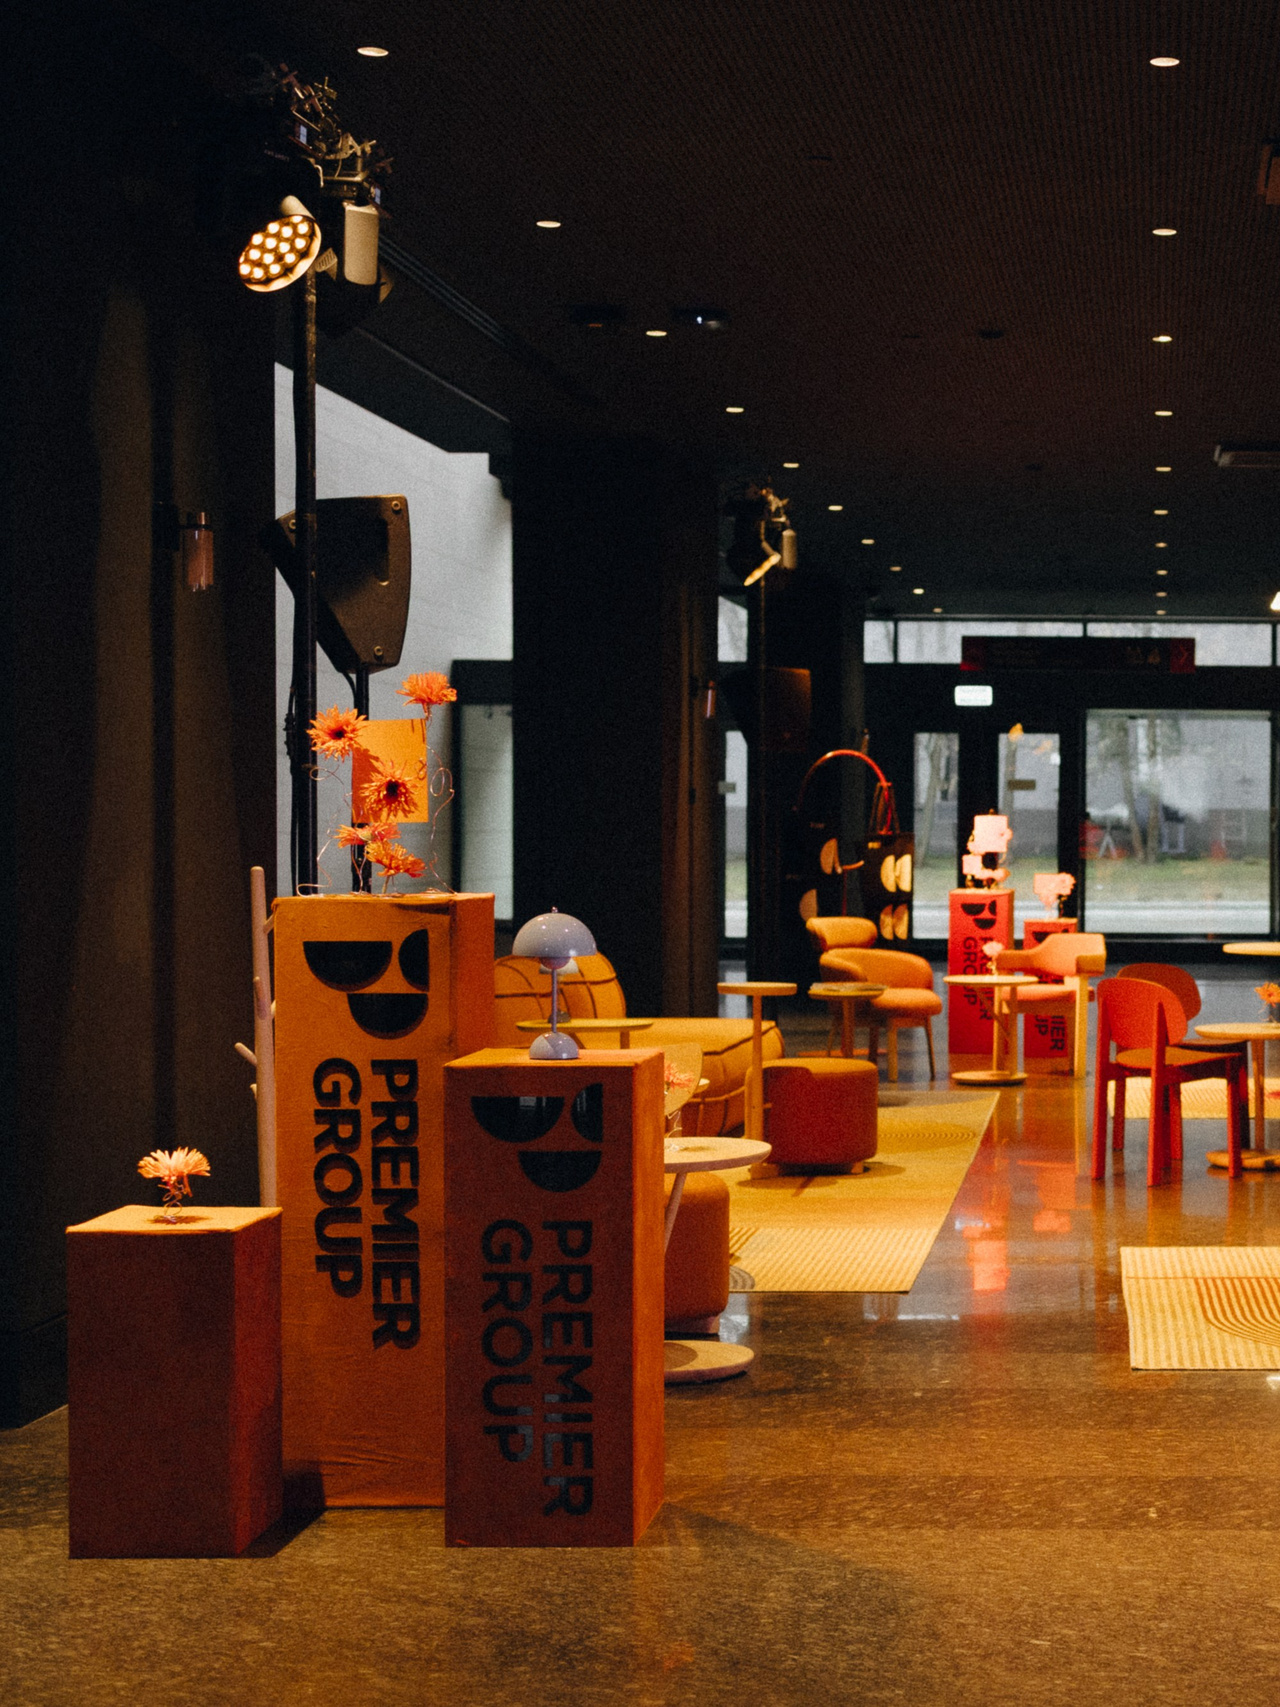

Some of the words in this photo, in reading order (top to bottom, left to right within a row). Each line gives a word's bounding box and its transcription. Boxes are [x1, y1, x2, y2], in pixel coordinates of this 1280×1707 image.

[313, 1058, 362, 1299] GROUP
[372, 1058, 421, 1350] PREMIER
[481, 1218, 534, 1464] GROUP
[541, 1219, 594, 1518] PREMIER
